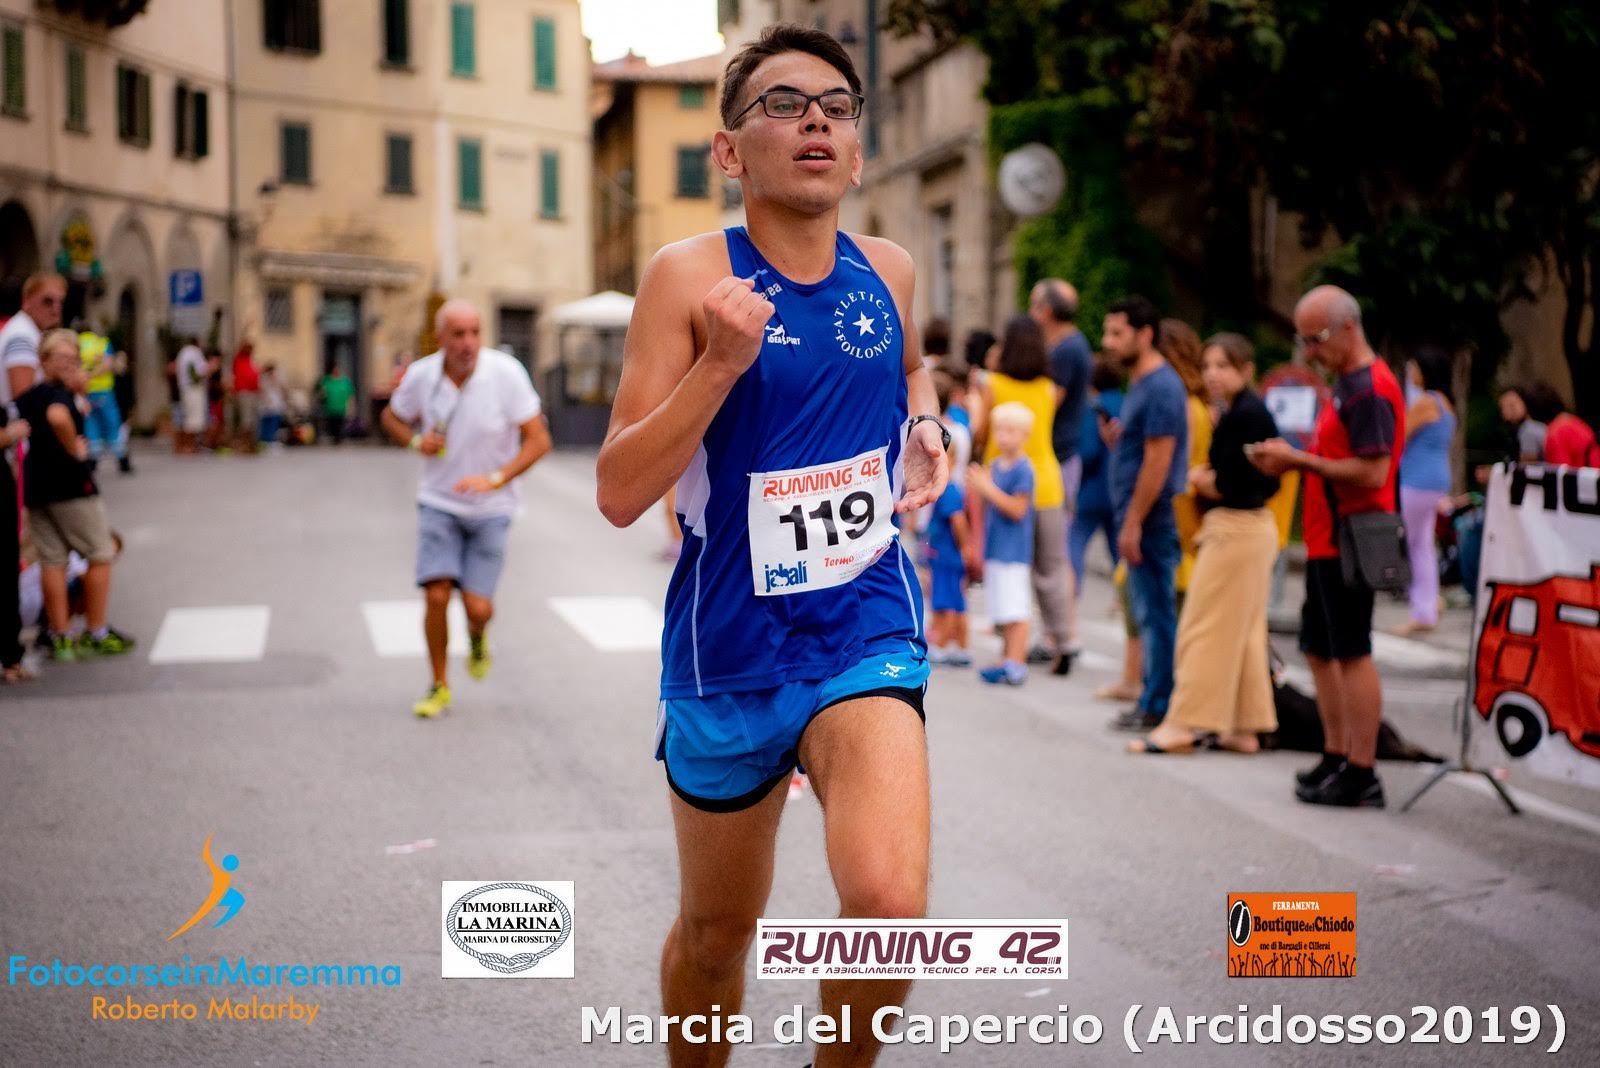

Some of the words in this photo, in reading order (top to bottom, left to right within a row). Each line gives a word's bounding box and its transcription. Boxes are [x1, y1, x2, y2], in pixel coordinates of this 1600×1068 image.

[833, 291, 893, 328] ATLETICA
[763, 467, 853, 498] RUNNING
[860, 457, 882, 476] 42
[779, 490, 875, 552] 119
